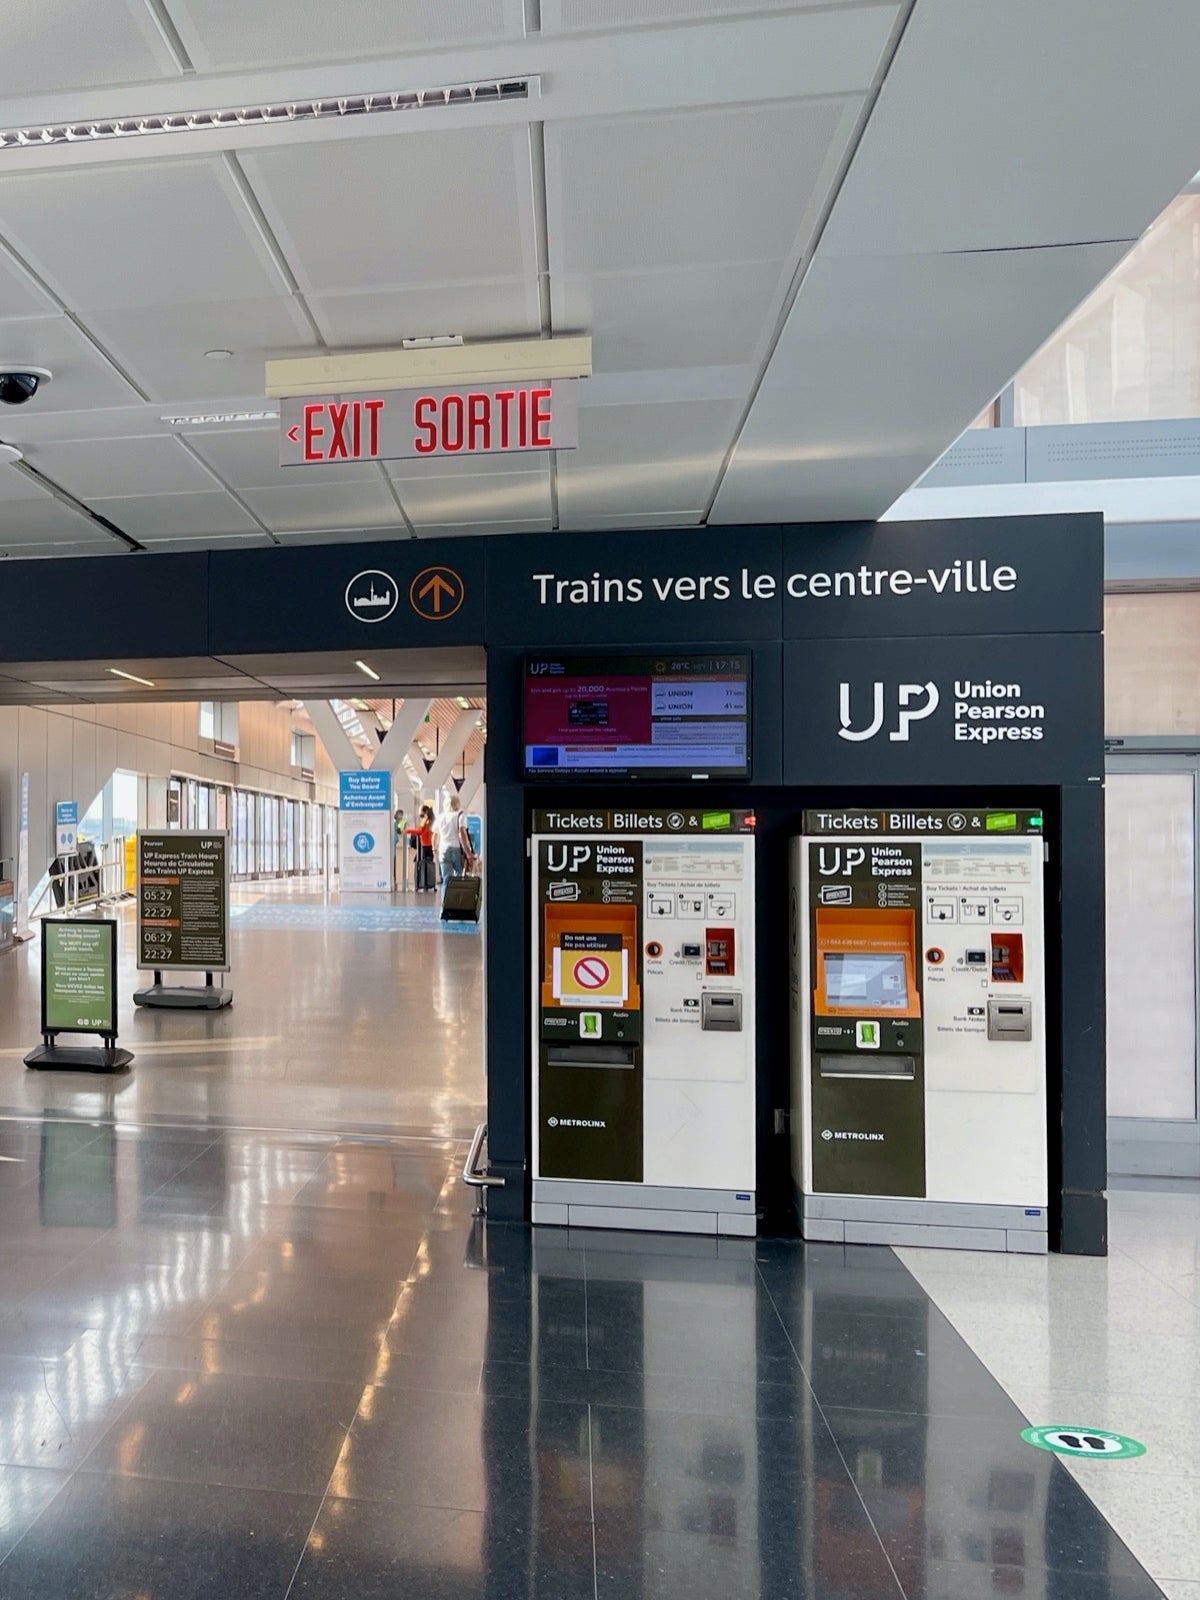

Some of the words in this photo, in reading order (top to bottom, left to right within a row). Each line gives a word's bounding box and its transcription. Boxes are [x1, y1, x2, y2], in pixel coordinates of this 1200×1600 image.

[303, 400, 384, 462] EXIT
[414, 388, 552, 454] SORTIE
[532, 572, 644, 605] Trains
[652, 573, 731, 602] vers
[742, 569, 778, 599] le
[786, 559, 1019, 598] centre-ville
[953, 680, 1022, 700] Union
[838, 680, 940, 742] UP
[953, 701, 1045, 721] Pearson
[953, 723, 1044, 744] Express
[546, 813, 603, 828] Tickets
[613, 813, 663, 828] Billets
[688, 816, 698, 826] &
[817, 813, 879, 829] Tickets
[889, 813, 943, 829] Billets
[971, 817, 981, 827] &
[200, 841, 213, 849] UP
[596, 845, 625, 854] Union
[181, 852, 198, 860] Train
[871, 847, 902, 857] Union
[548, 845, 591, 872] UP
[596, 855, 635, 864] Pearson
[819, 847, 866, 876] UP
[871, 857, 913, 867] Pearson
[596, 864, 634, 874] Express
[871, 867, 912, 877] Express
[144, 891, 172, 901] 05:27
[144, 908, 172, 918] 22:27
[144, 933, 172, 942] 06:27
[574, 942, 586, 950] pas
[144, 950, 172, 959] 22:27
[559, 1119, 606, 1128] METROLINX
[834, 1132, 884, 1141] METROLINX
